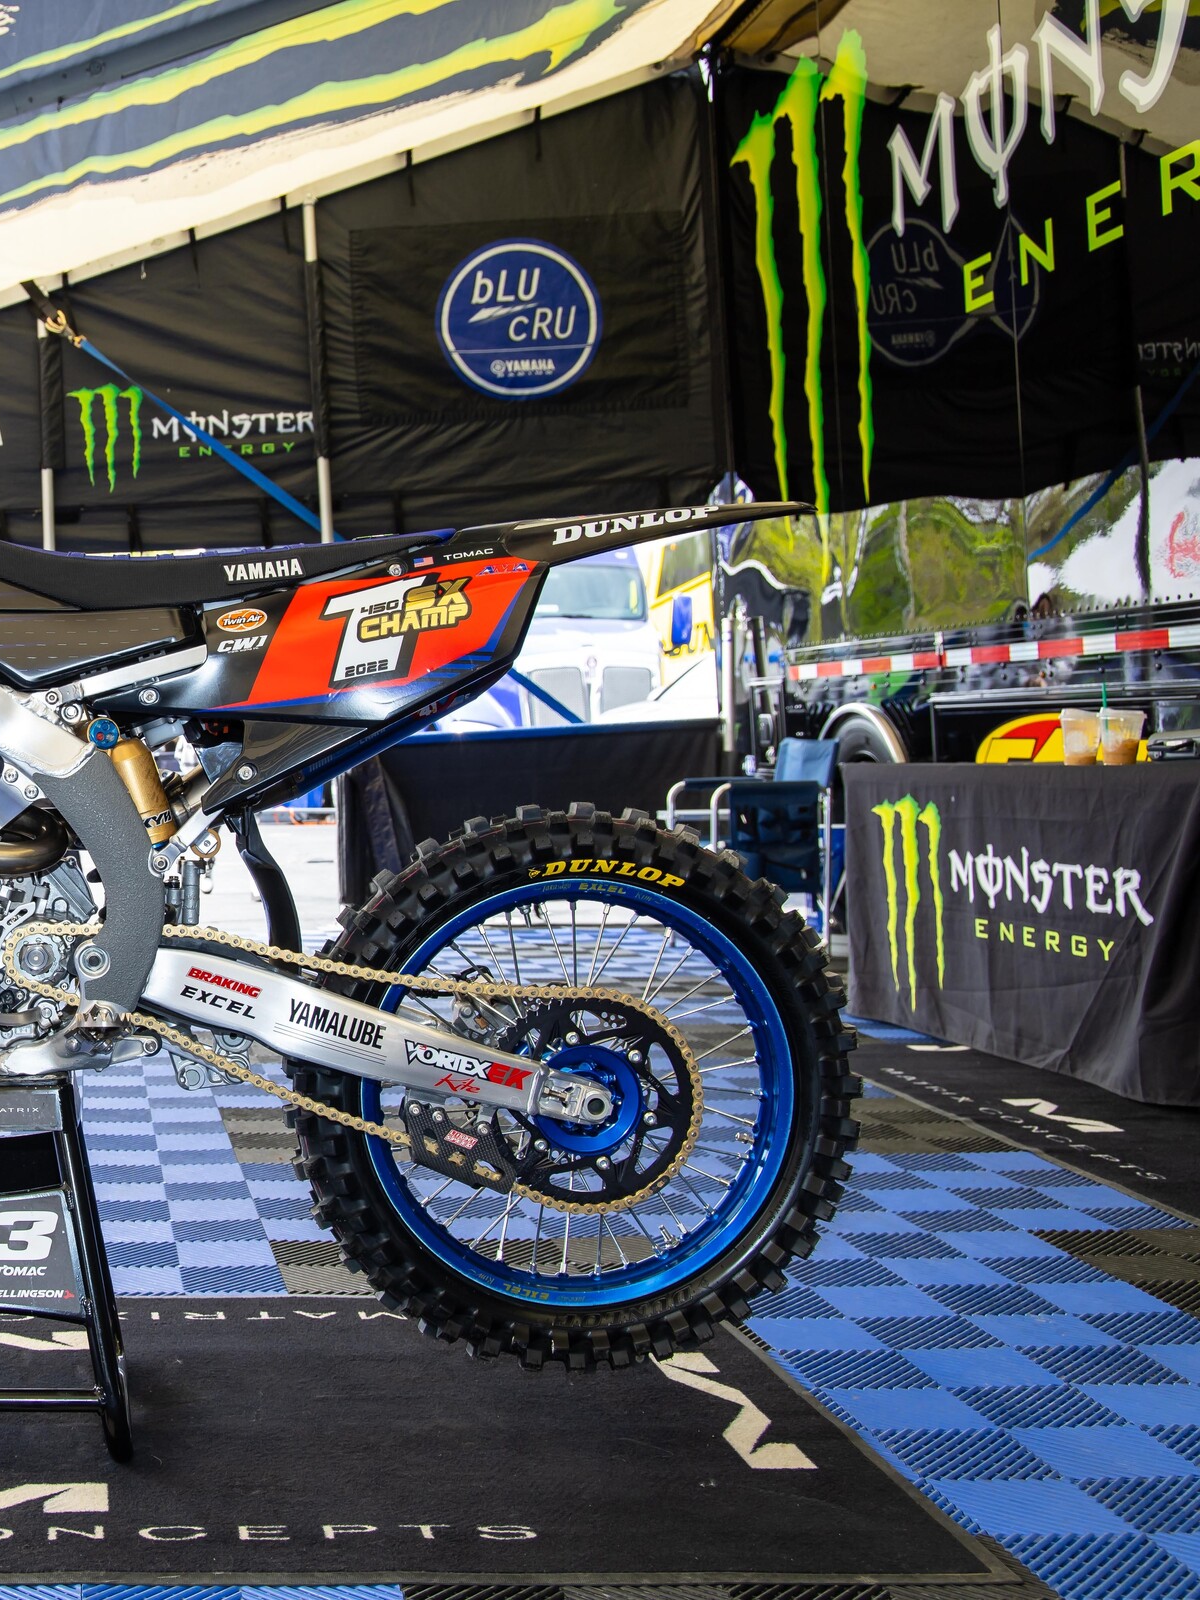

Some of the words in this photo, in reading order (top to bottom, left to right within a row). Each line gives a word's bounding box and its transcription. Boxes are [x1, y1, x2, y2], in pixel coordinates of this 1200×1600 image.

[505, 358, 555, 371] YAMAHA
[179, 442, 295, 458] ENRGY
[552, 506, 719, 545] DUNLOP
[443, 548, 493, 560] TOMAC
[224, 557, 303, 582] YAMAHA
[360, 600, 399, 616] 450
[406, 579, 470, 612] SX
[223, 616, 246, 626] Twin
[247, 614, 262, 623] Air
[360, 604, 468, 640] CHAMP
[345, 659, 388, 678] 2022
[542, 859, 685, 887] DUNLOP
[948, 844, 1154, 926] MONSTER
[578, 883, 626, 894] EXCEL
[975, 918, 1114, 961] ENERGY
[186, 966, 263, 999] BRAKING
[180, 985, 256, 1019] EXCEL
[289, 998, 387, 1049] YAMALUBE
[405, 1039, 492, 1080] VORTEX
[487, 1062, 533, 1090] EK
[880, 1067, 974, 1103] MATRIX
[978, 1106, 1167, 1180] CONCEPTS
[503, 1283, 549, 1300] EXCEL
